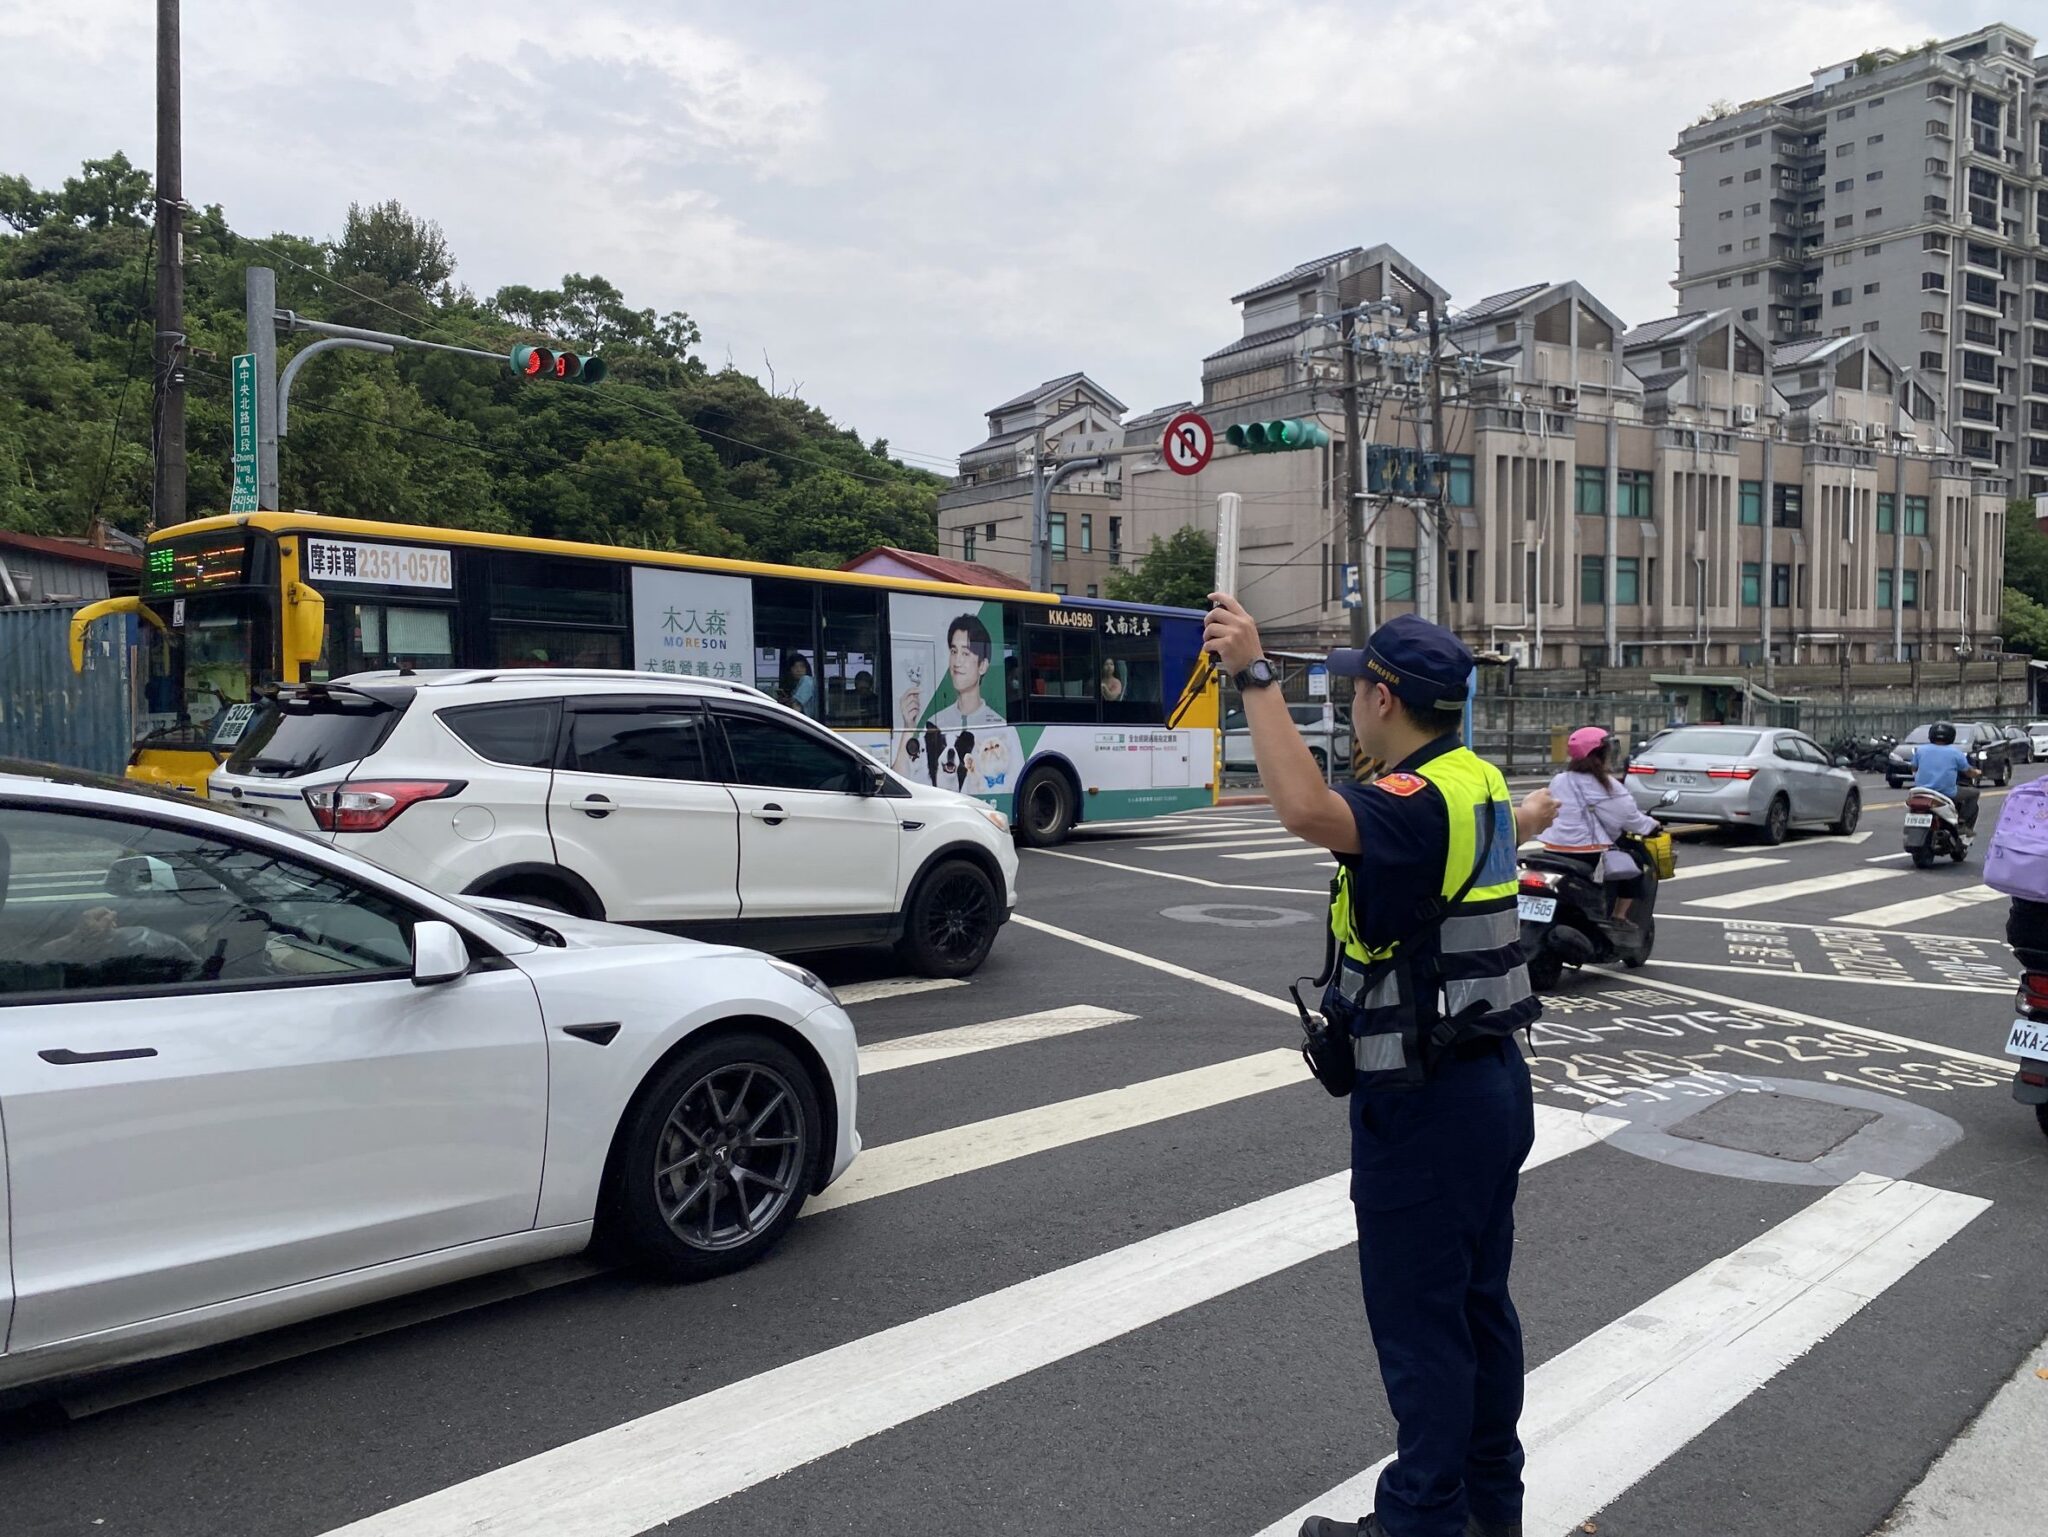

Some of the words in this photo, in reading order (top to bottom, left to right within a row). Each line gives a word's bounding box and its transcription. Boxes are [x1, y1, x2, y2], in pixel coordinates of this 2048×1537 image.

[239, 369, 251, 452] 中央北路四段
[236, 453, 254, 463] Zhong
[236, 464, 250, 474] Yang
[245, 475, 256, 484] Rd.
[234, 486, 249, 495] Sec.
[251, 484, 256, 493] 4
[310, 544, 357, 577] 摩菲爾
[358, 548, 450, 583] 2351-0578
[661, 605, 728, 636] 木入森
[1048, 609, 1093, 628] KKA-0589
[1105, 614, 1152, 637] 大南汽車
[663, 636, 727, 650] MORESON
[643, 658, 743, 679] 犬貓營養分類
[227, 704, 255, 722] 302
[1519, 901, 1553, 917] T-1505
